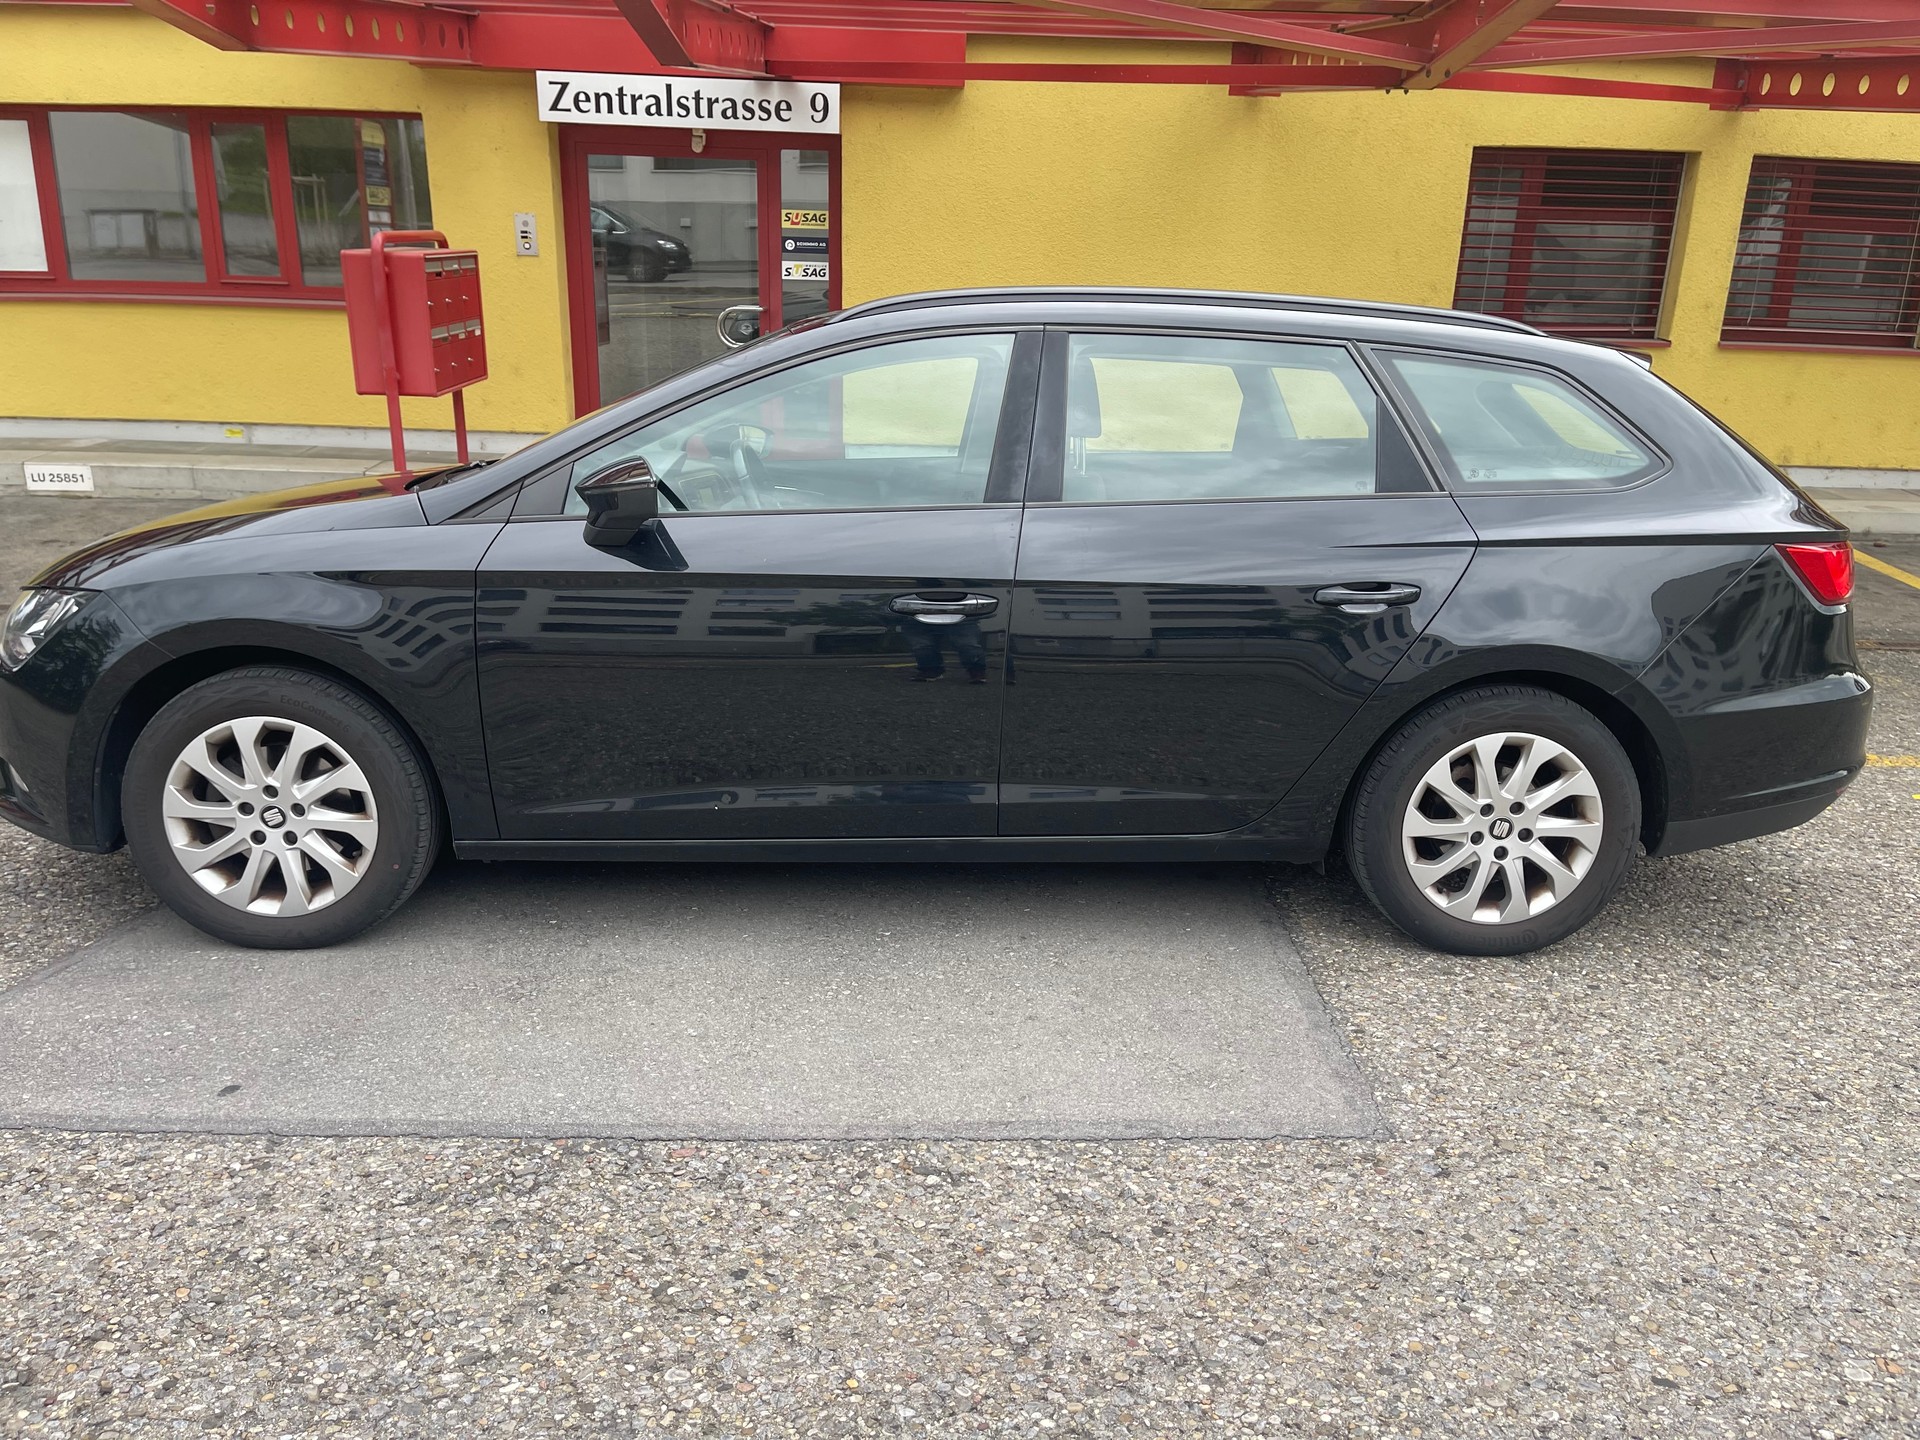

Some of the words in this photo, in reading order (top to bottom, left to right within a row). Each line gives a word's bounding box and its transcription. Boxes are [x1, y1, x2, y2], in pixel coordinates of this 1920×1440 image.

[548, 80, 793, 121] Zentralstrasse
[810, 92, 830, 123] 9
[784, 212, 826, 225] SUSAG
[31, 473, 46, 483] LU
[48, 473, 85, 483] 25851
